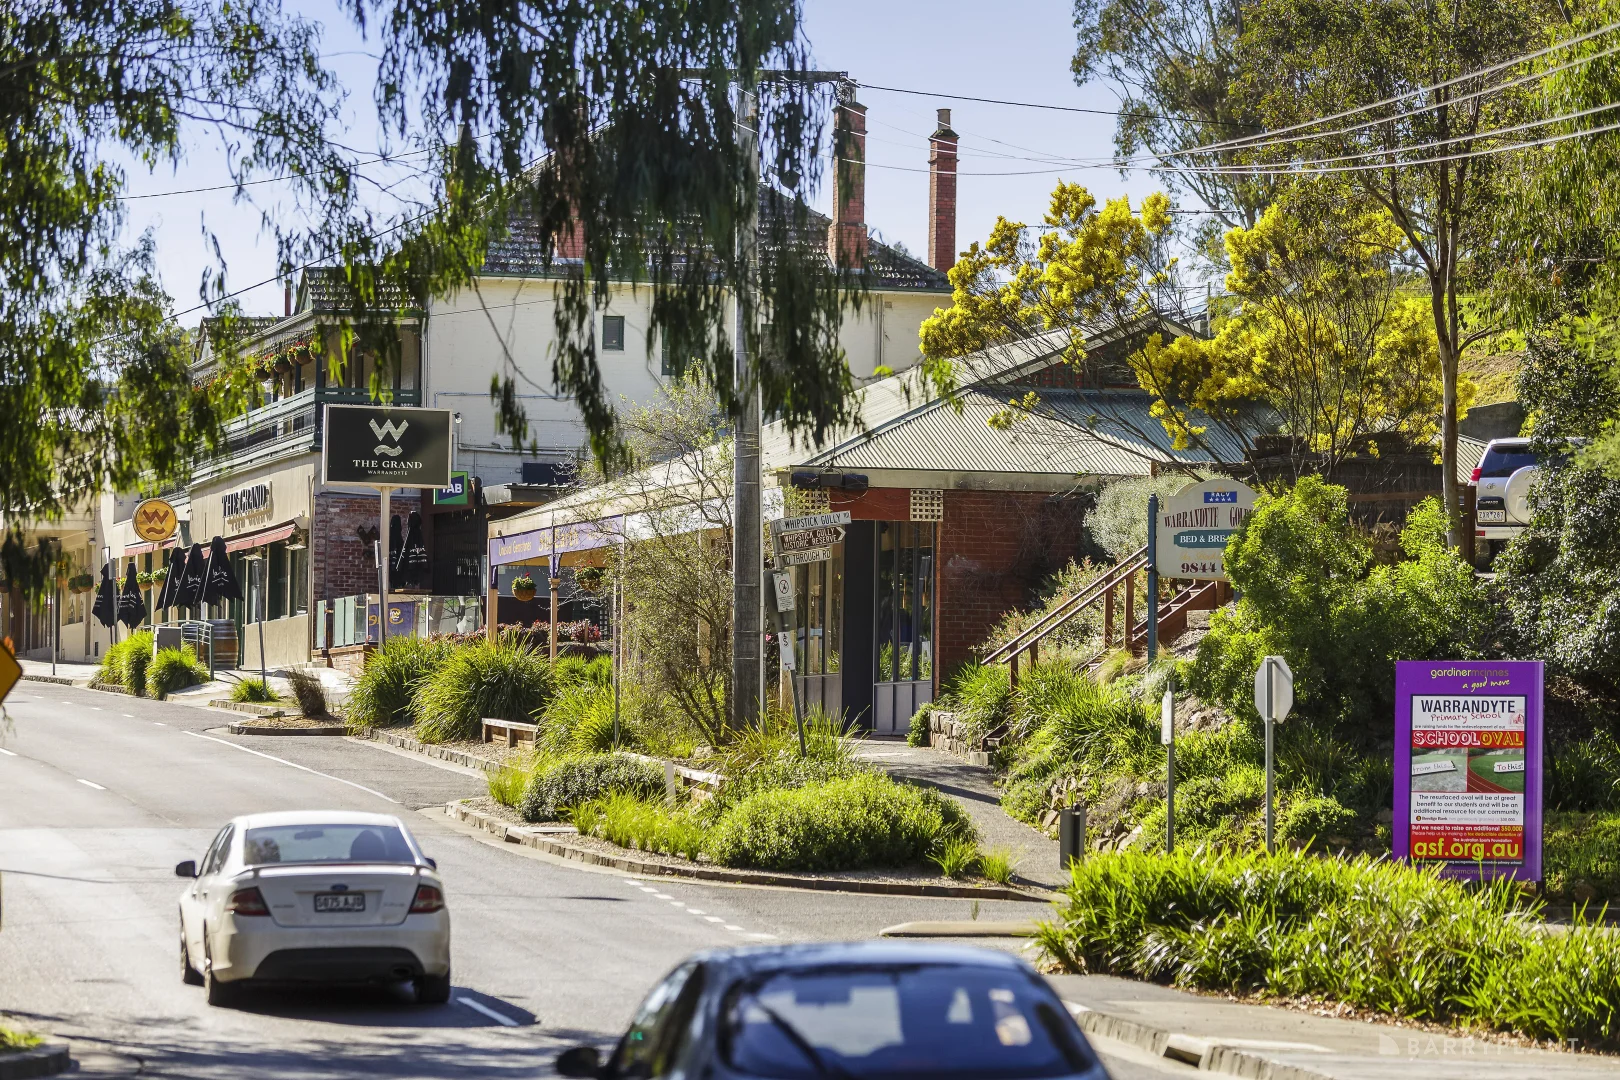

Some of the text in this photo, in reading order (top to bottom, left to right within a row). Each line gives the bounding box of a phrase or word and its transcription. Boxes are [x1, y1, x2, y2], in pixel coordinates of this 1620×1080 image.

[353, 459, 423, 469] THE GRAND
[222, 484, 268, 517] THE GRAND
[784, 516, 819, 530] WHIPSTICK
[820, 513, 841, 525] GULLY
[1164, 506, 1219, 528] WARRANDYTE
[783, 534, 837, 550] HISTORIC RESERVE
[784, 527, 835, 542] WHIPSTICK GULLY
[1180, 535, 1198, 543] BED
[1199, 534, 1206, 543] &
[793, 550, 820, 563] THROUGH
[822, 549, 831, 559] RD
[1181, 562, 1217, 573] 9844
[1470, 676, 1488, 692] good
[1490, 679, 1510, 687] move
[1421, 699, 1516, 714] WARRANDYTE
[1430, 712, 1468, 725] Primary
[1470, 711, 1502, 720] School
[1413, 837, 1519, 861] asf.org.au
